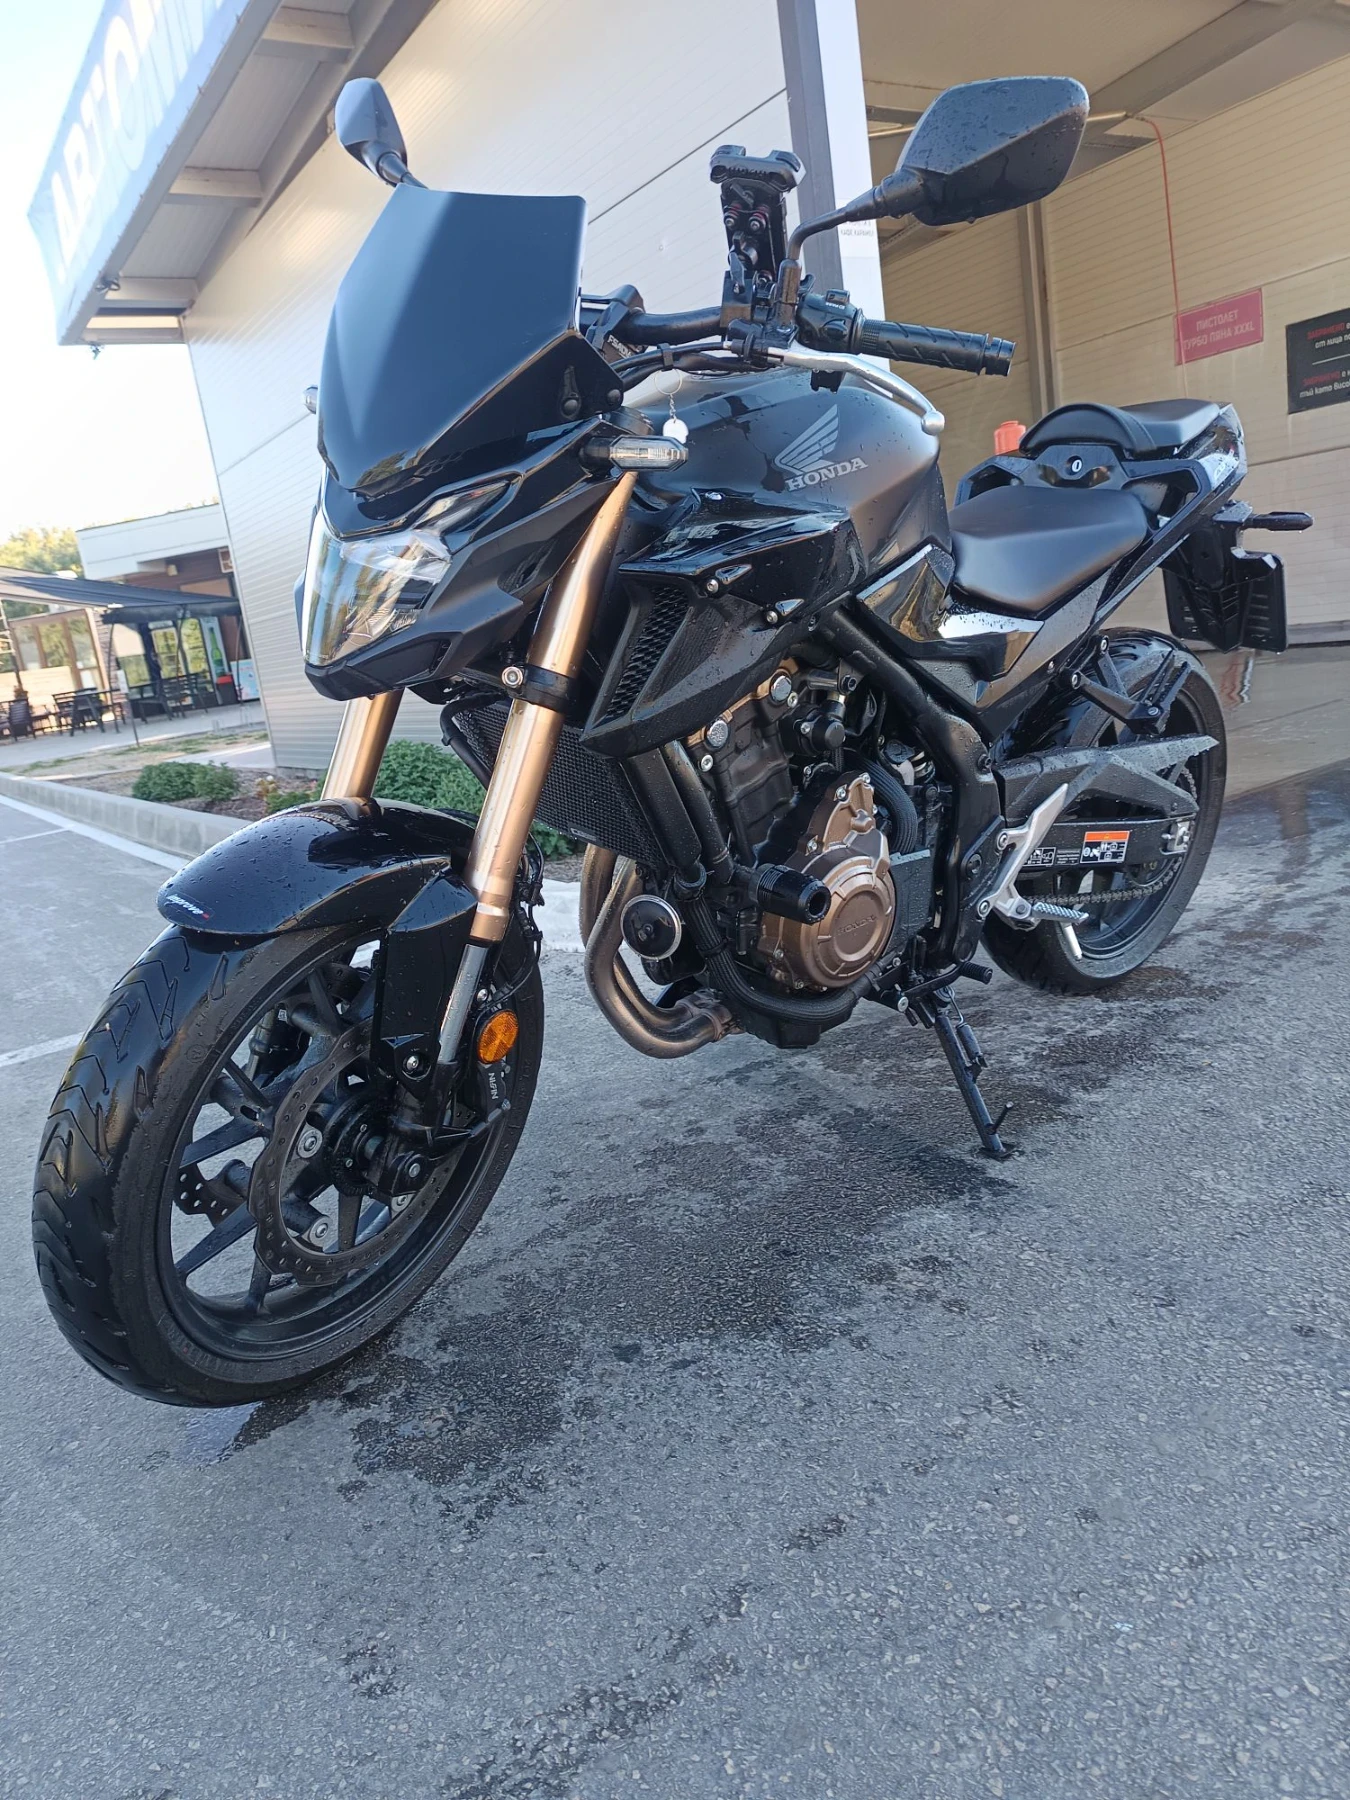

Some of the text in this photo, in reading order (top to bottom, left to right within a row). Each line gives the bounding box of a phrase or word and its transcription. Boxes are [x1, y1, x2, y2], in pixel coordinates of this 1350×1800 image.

[1196, 309, 1239, 332] ПИСТОЛЕТ
[1209, 328, 1233, 343] ПЯНА
[785, 457, 869, 492] HONDA
